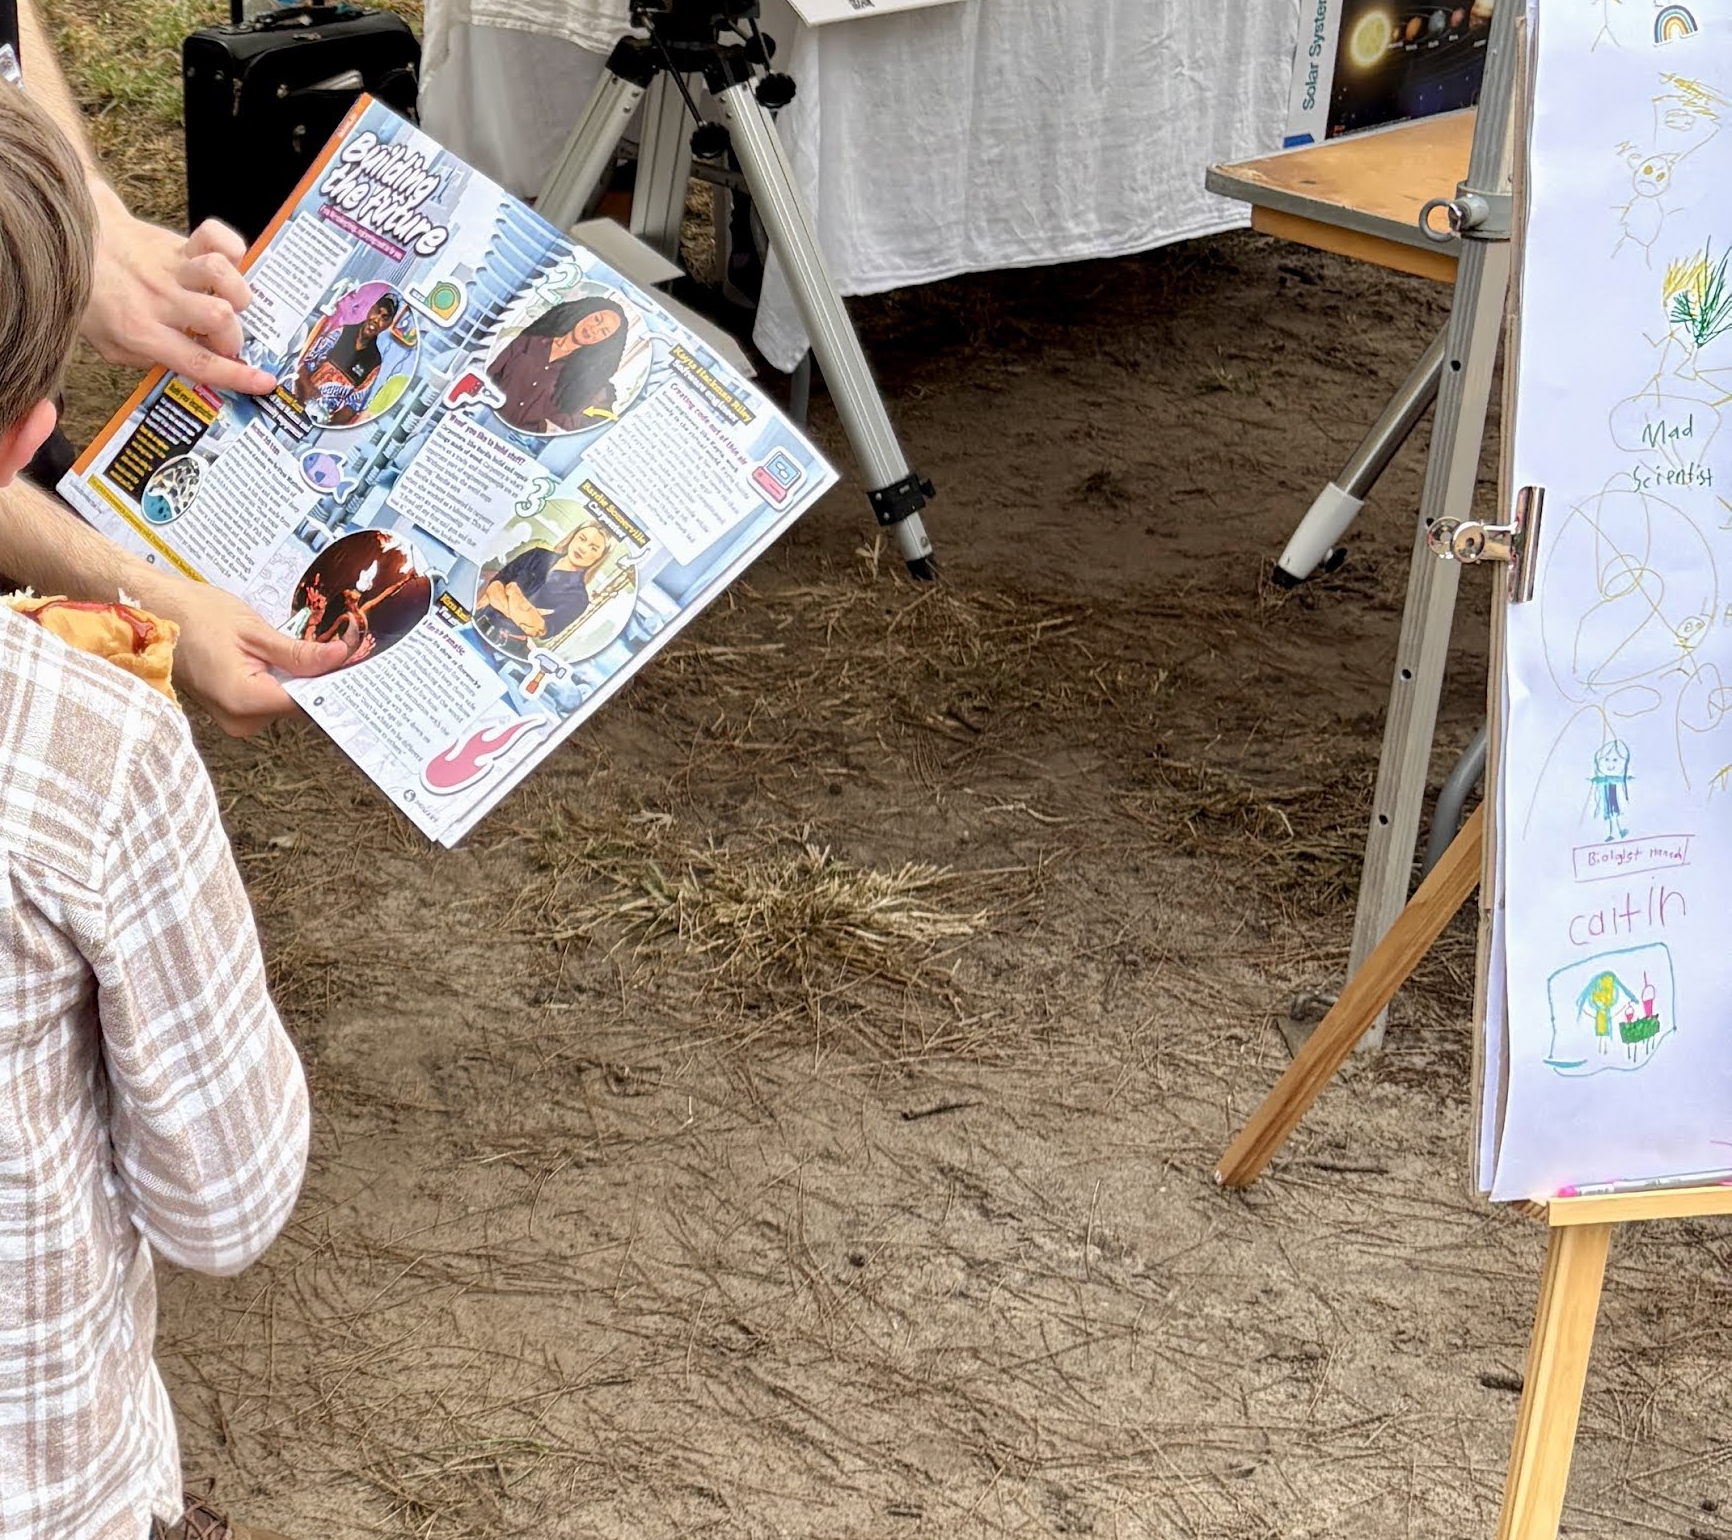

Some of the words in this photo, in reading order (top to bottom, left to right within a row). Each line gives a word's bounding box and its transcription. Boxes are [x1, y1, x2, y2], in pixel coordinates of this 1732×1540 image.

[1303, 62, 1318, 111] Solar
[341, 131, 441, 211] Building
[320, 163, 370, 210] the
[358, 185, 449, 257] future
[668, 381, 697, 409] Creating
[693, 406, 711, 424] code
[707, 422, 721, 436] out
[1642, 413, 1693, 448] Mad
[464, 425, 477, 437] you
[476, 430, 488, 442] like
[1633, 462, 1713, 493] Scientist
